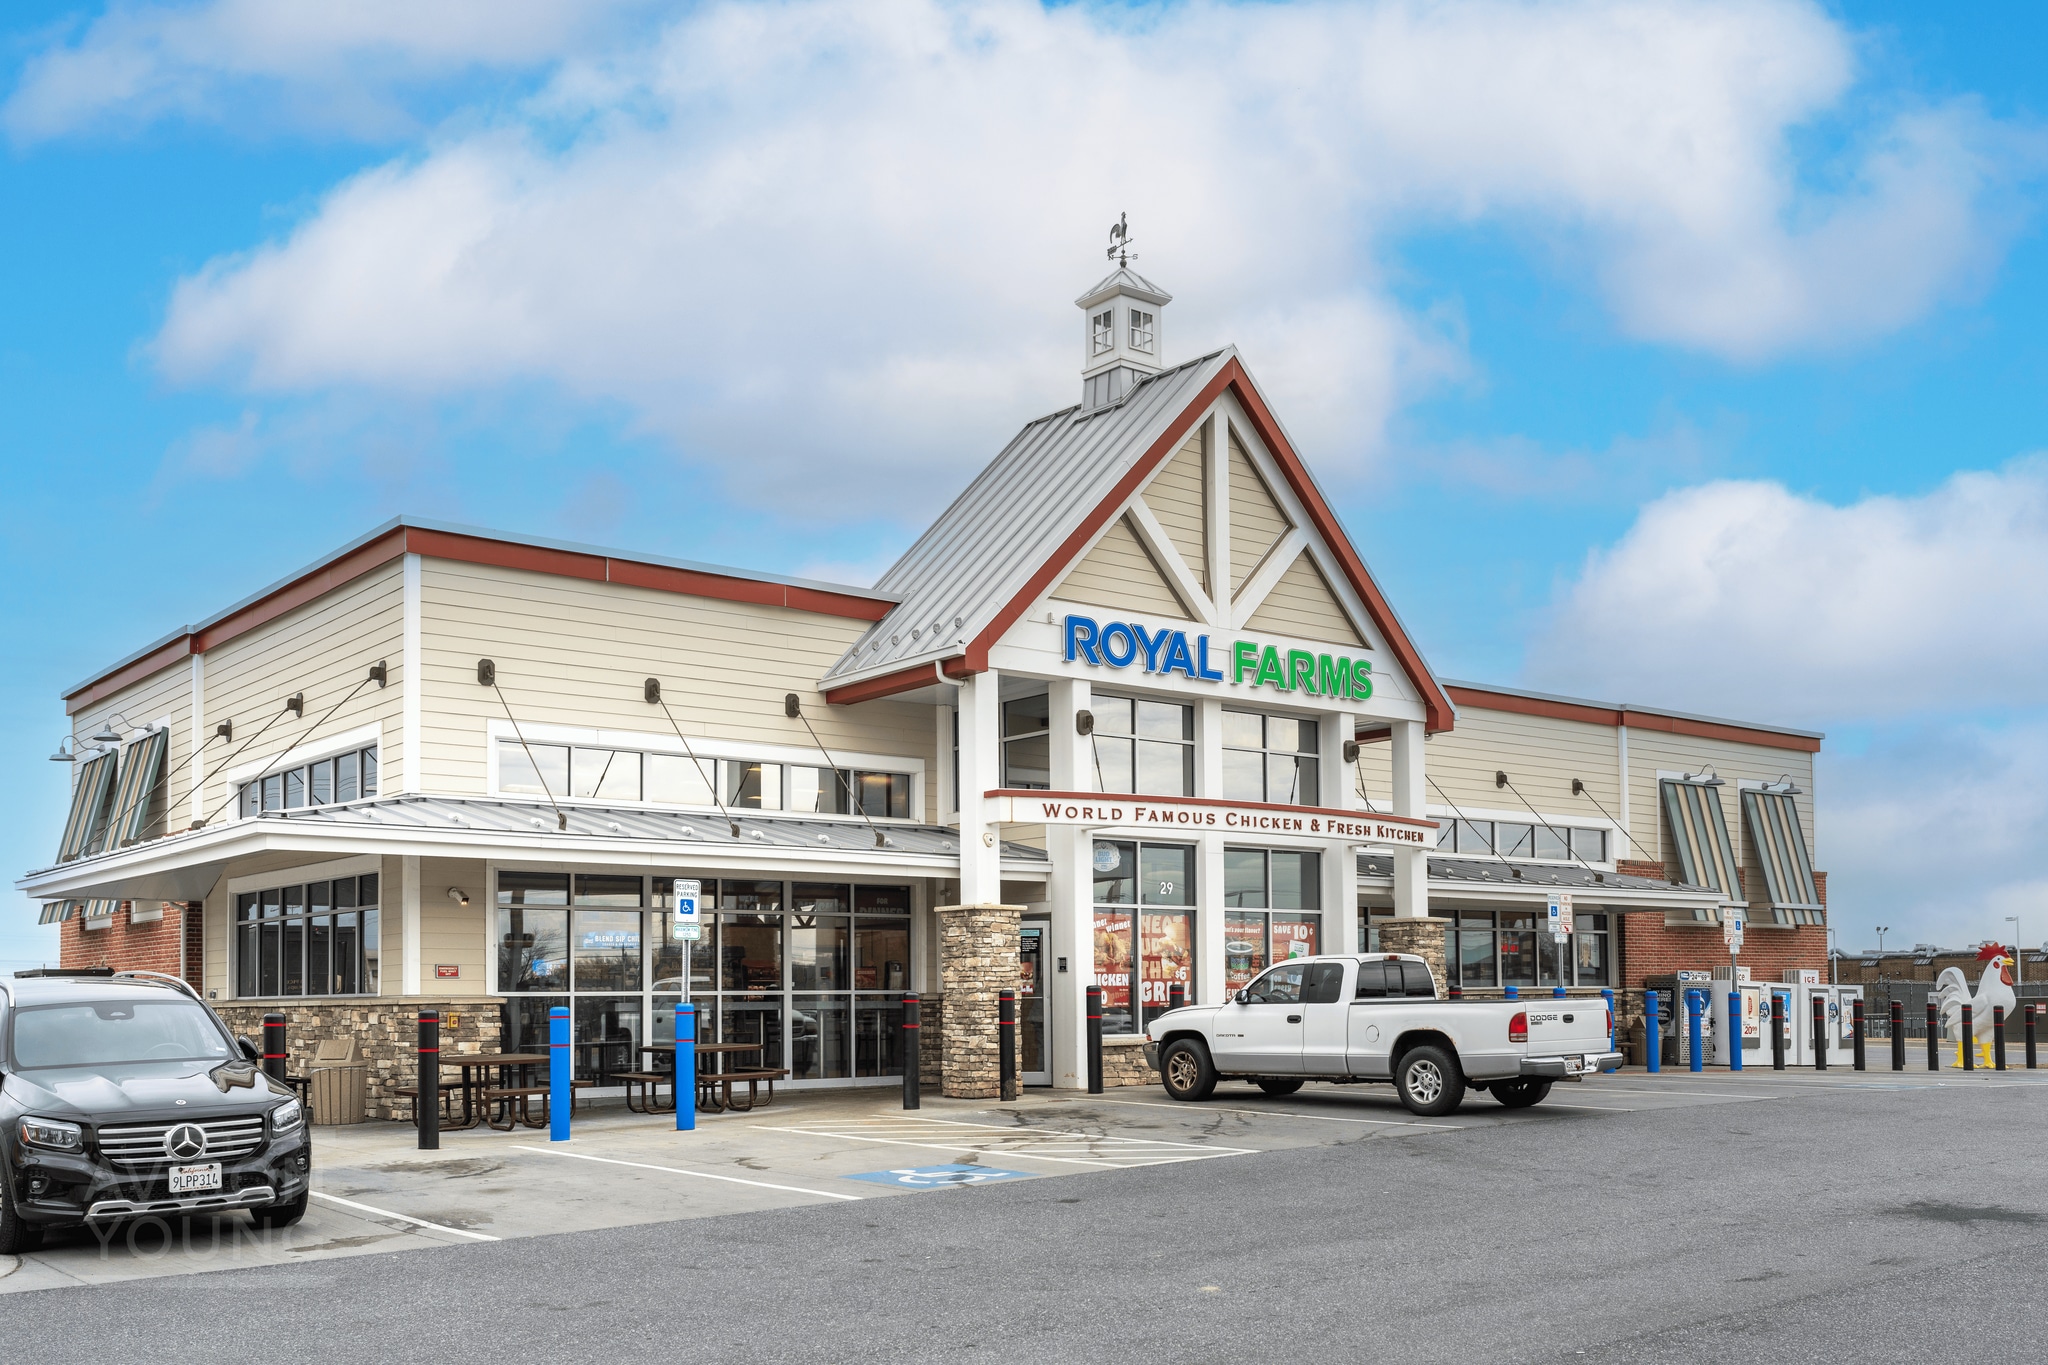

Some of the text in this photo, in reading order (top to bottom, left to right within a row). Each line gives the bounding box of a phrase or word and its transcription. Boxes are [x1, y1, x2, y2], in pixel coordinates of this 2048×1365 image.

[1063, 615, 1374, 701] ROYAL FARMS
[1043, 803, 1424, 843] WORLD FAMOUS CHICKEN & FRESH KITCHEN
[676, 883, 699, 891] RESERVED
[1160, 881, 1173, 895] 29
[876, 897, 888, 905] FOR
[1105, 920, 1131, 934] winner
[1274, 925, 1291, 934] SAVE
[1293, 924, 1308, 940] 10
[1804, 976, 1816, 984] ICE
[1530, 1014, 1558, 1022] DODGE
[173, 1173, 218, 1189] 9LPP314
